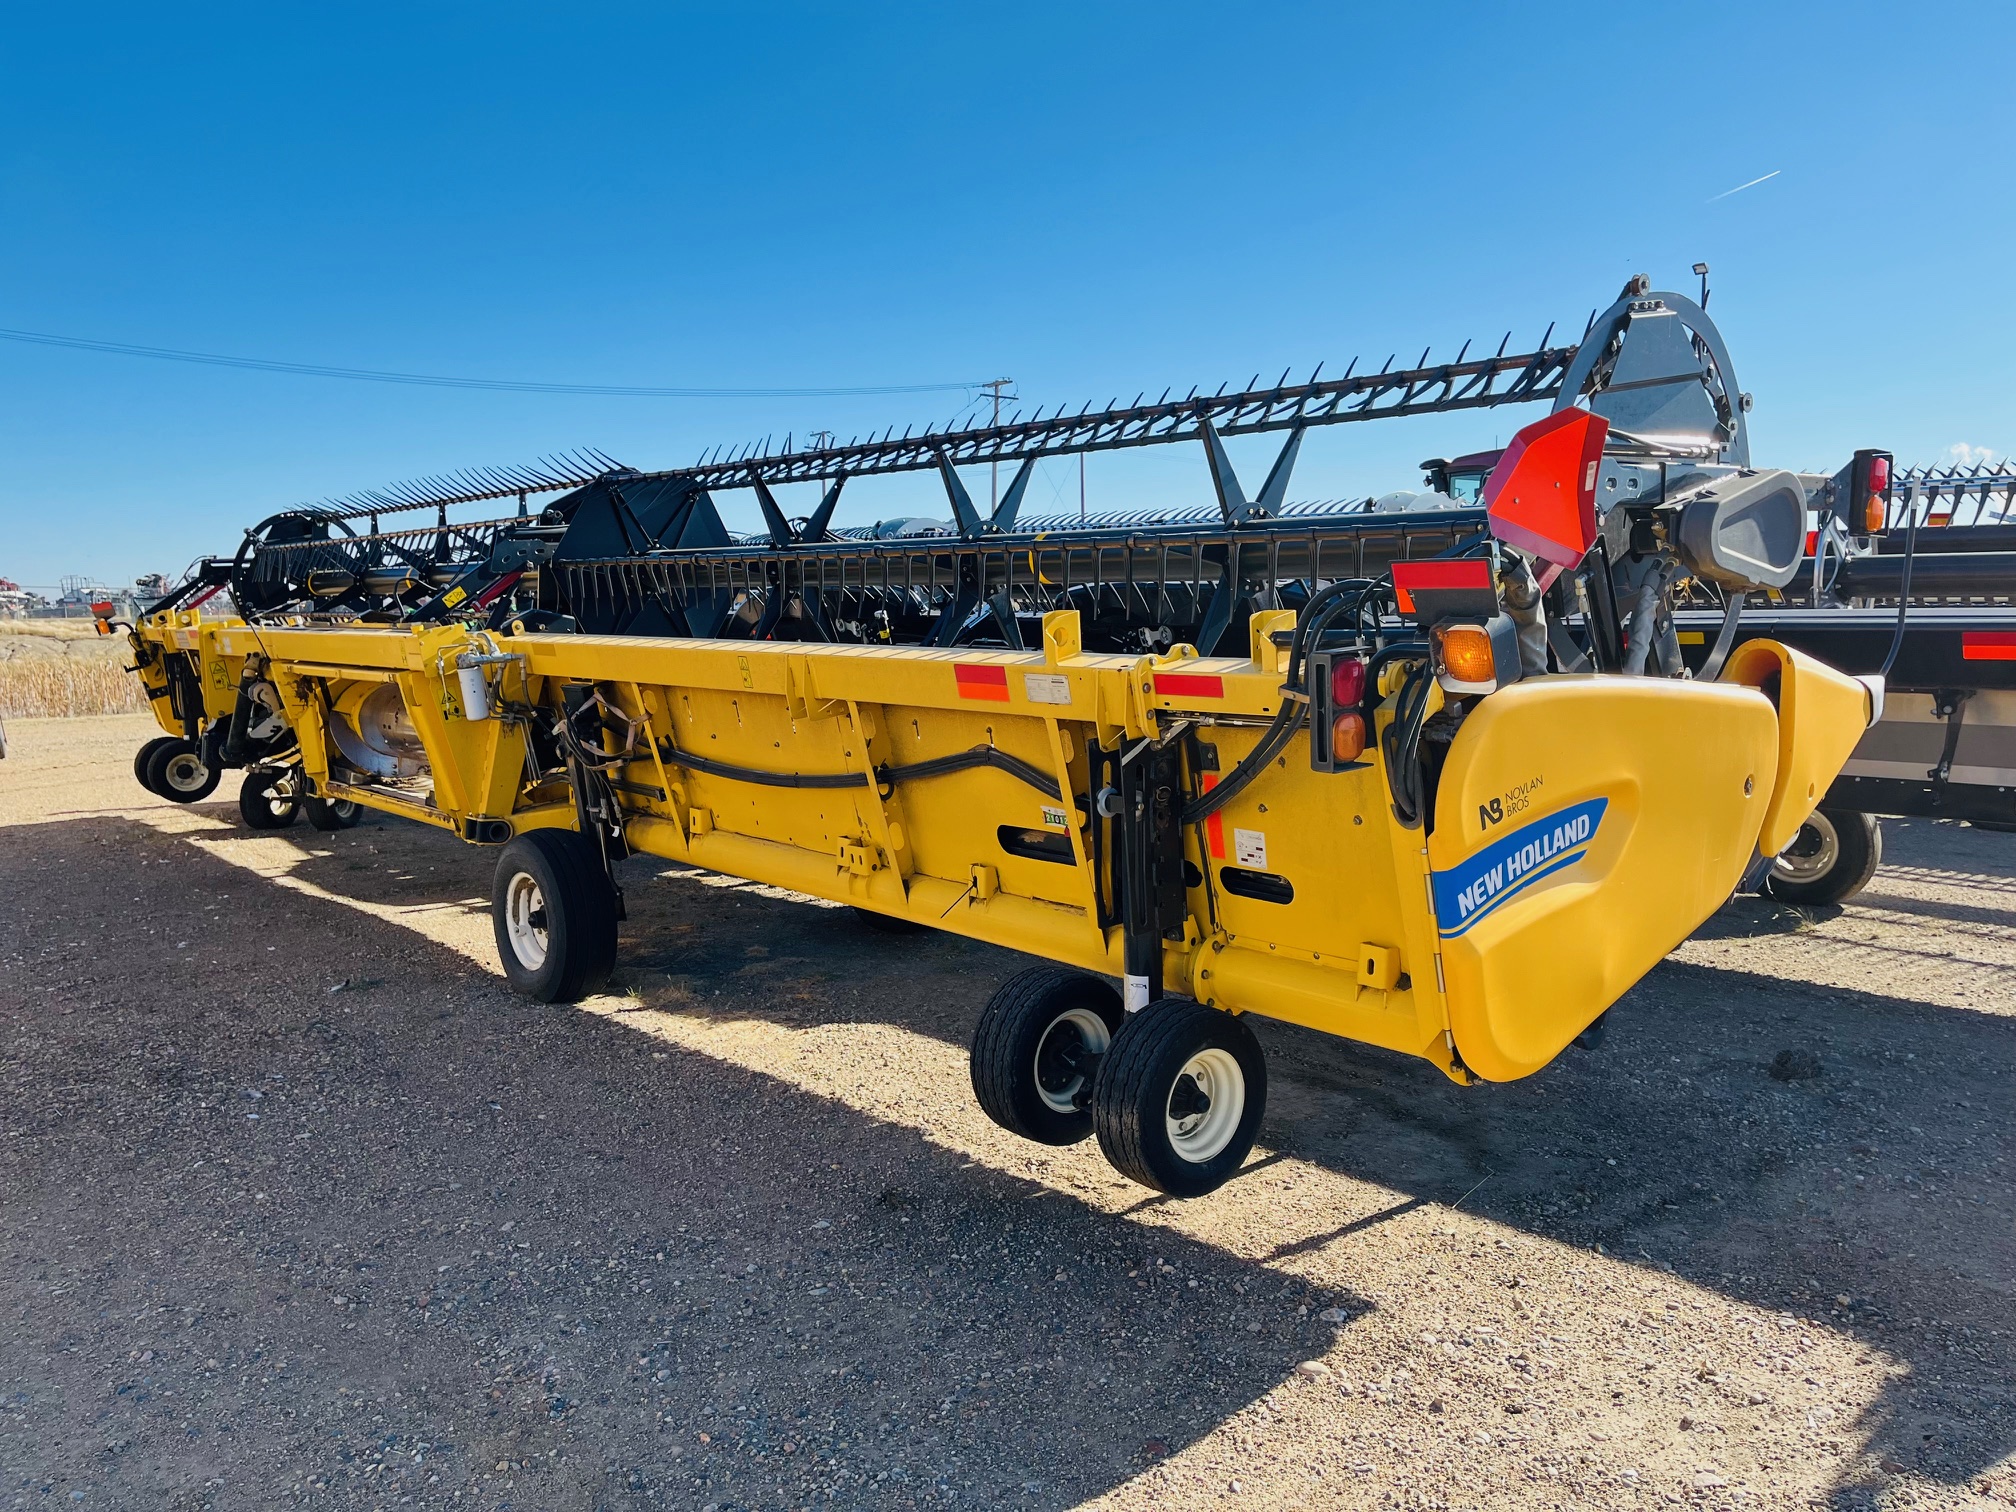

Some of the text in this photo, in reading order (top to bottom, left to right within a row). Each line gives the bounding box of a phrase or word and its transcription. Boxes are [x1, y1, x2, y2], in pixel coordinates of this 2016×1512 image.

[1506, 775, 1543, 803] NOVLAN
[1506, 795, 1529, 817] BROS
[1457, 813, 1589, 918] NEW HOLLAND
